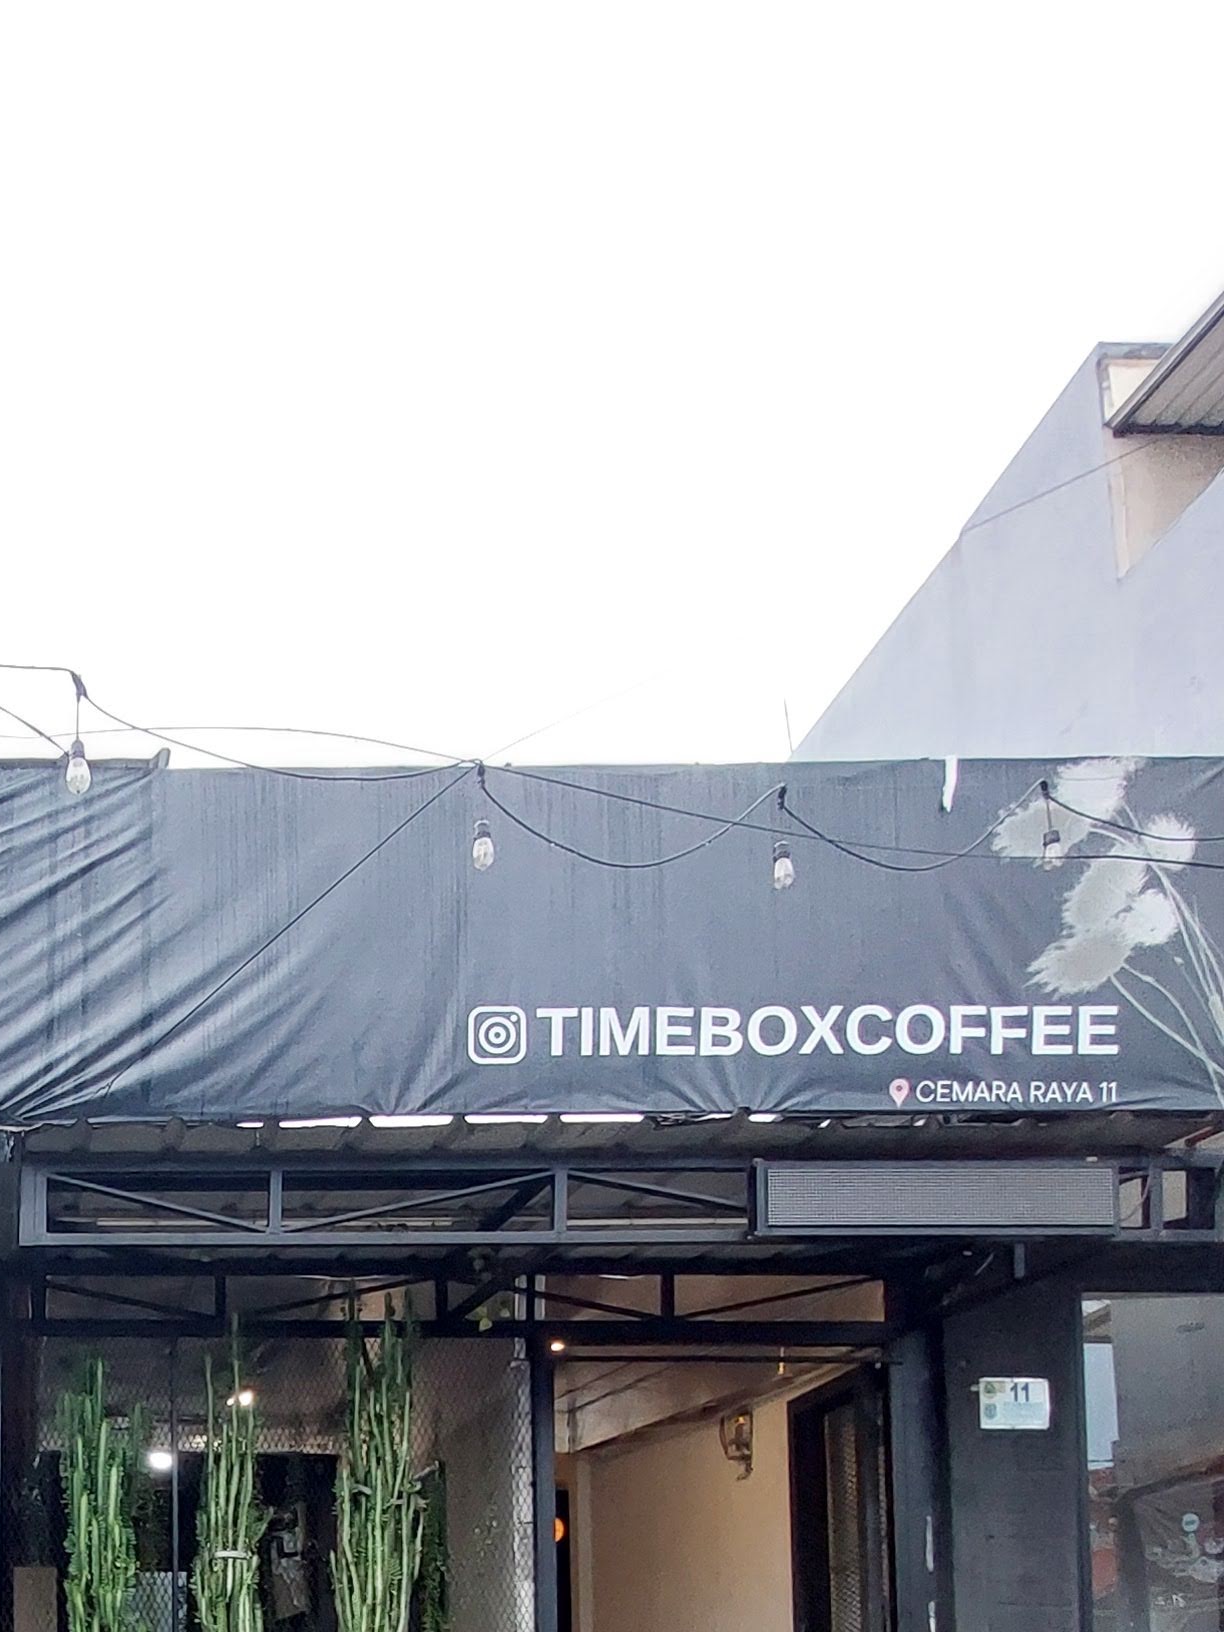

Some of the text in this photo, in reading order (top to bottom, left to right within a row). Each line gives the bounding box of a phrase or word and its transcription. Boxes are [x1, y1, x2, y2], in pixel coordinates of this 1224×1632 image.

[536, 1005, 1119, 1056] TIMEBOXCOFFEE
[916, 1080, 1117, 1103] CEMARA RAYA 11
[1010, 1382, 1030, 1402] 11
